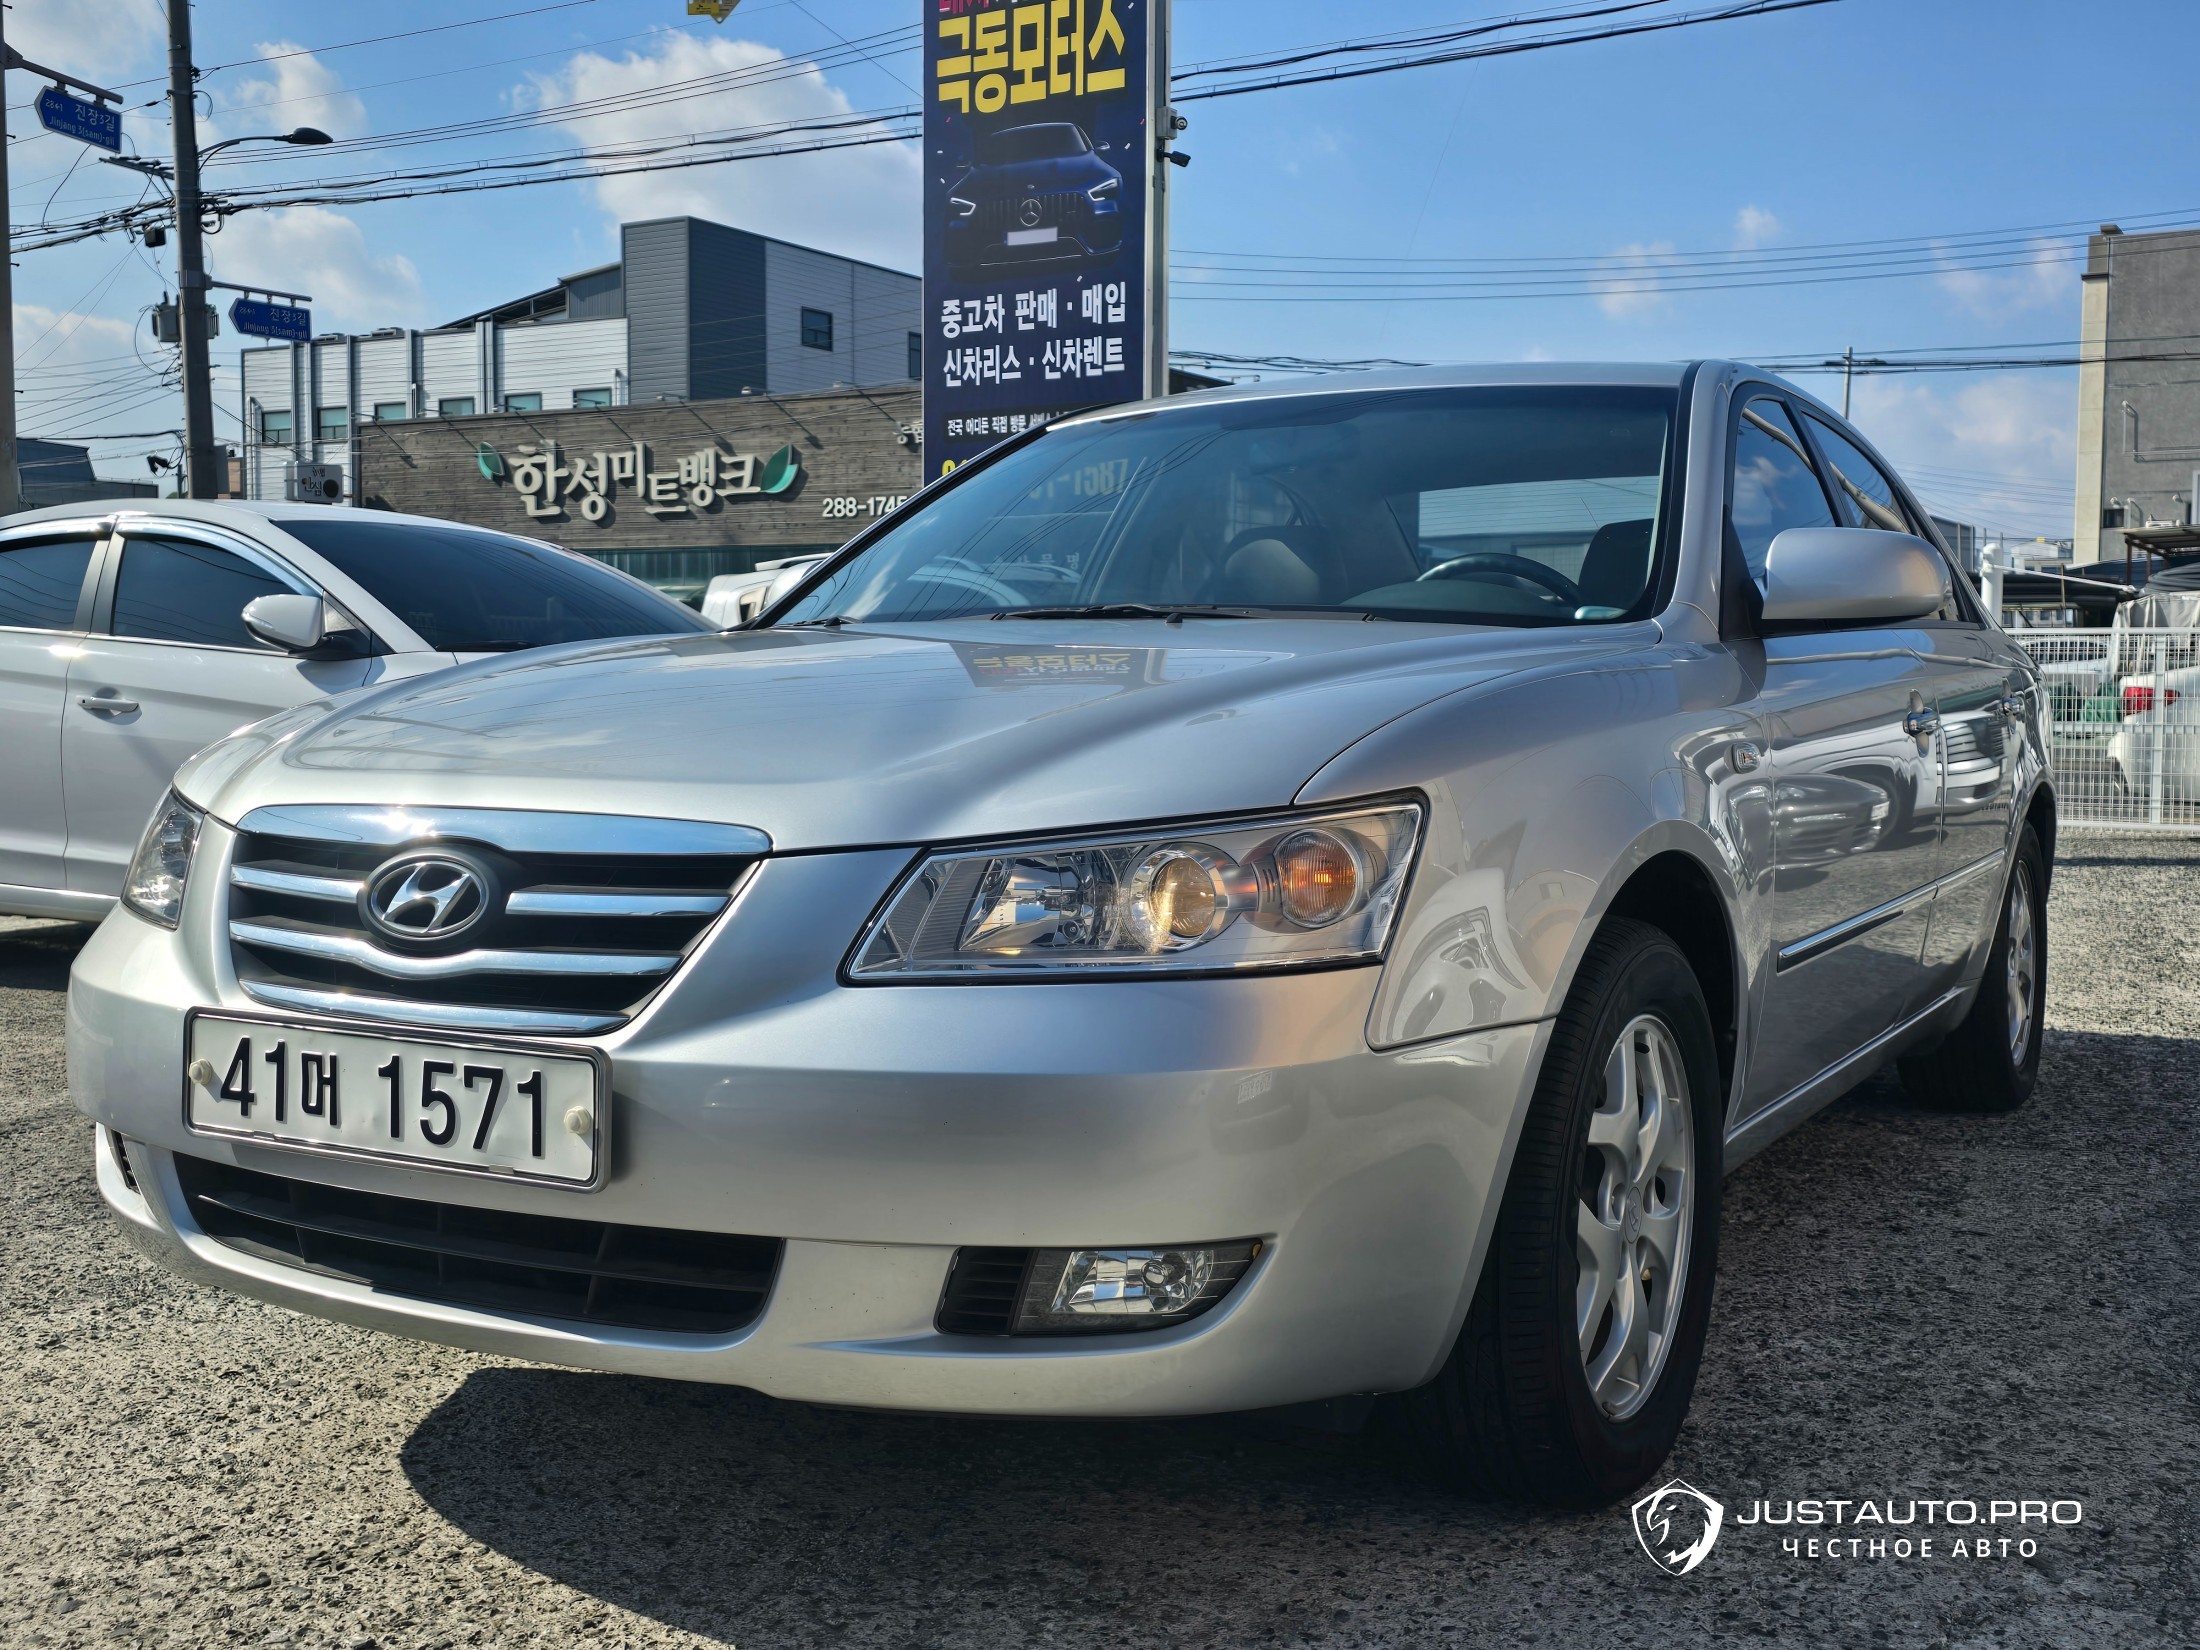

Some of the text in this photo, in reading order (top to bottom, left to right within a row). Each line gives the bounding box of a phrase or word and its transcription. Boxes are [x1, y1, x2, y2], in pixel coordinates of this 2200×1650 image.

[937, 0, 1126, 113] 극동모터스
[75, 103, 115, 133] 진장3길
[941, 281, 1126, 338] 중고차 판매 매입
[943, 335, 1125, 387] 신차리스 신차렌트
[947, 419, 963, 436] 전국
[508, 439, 762, 521] 한성미트뱅크
[220, 1037, 542, 1158] 41머 1571
